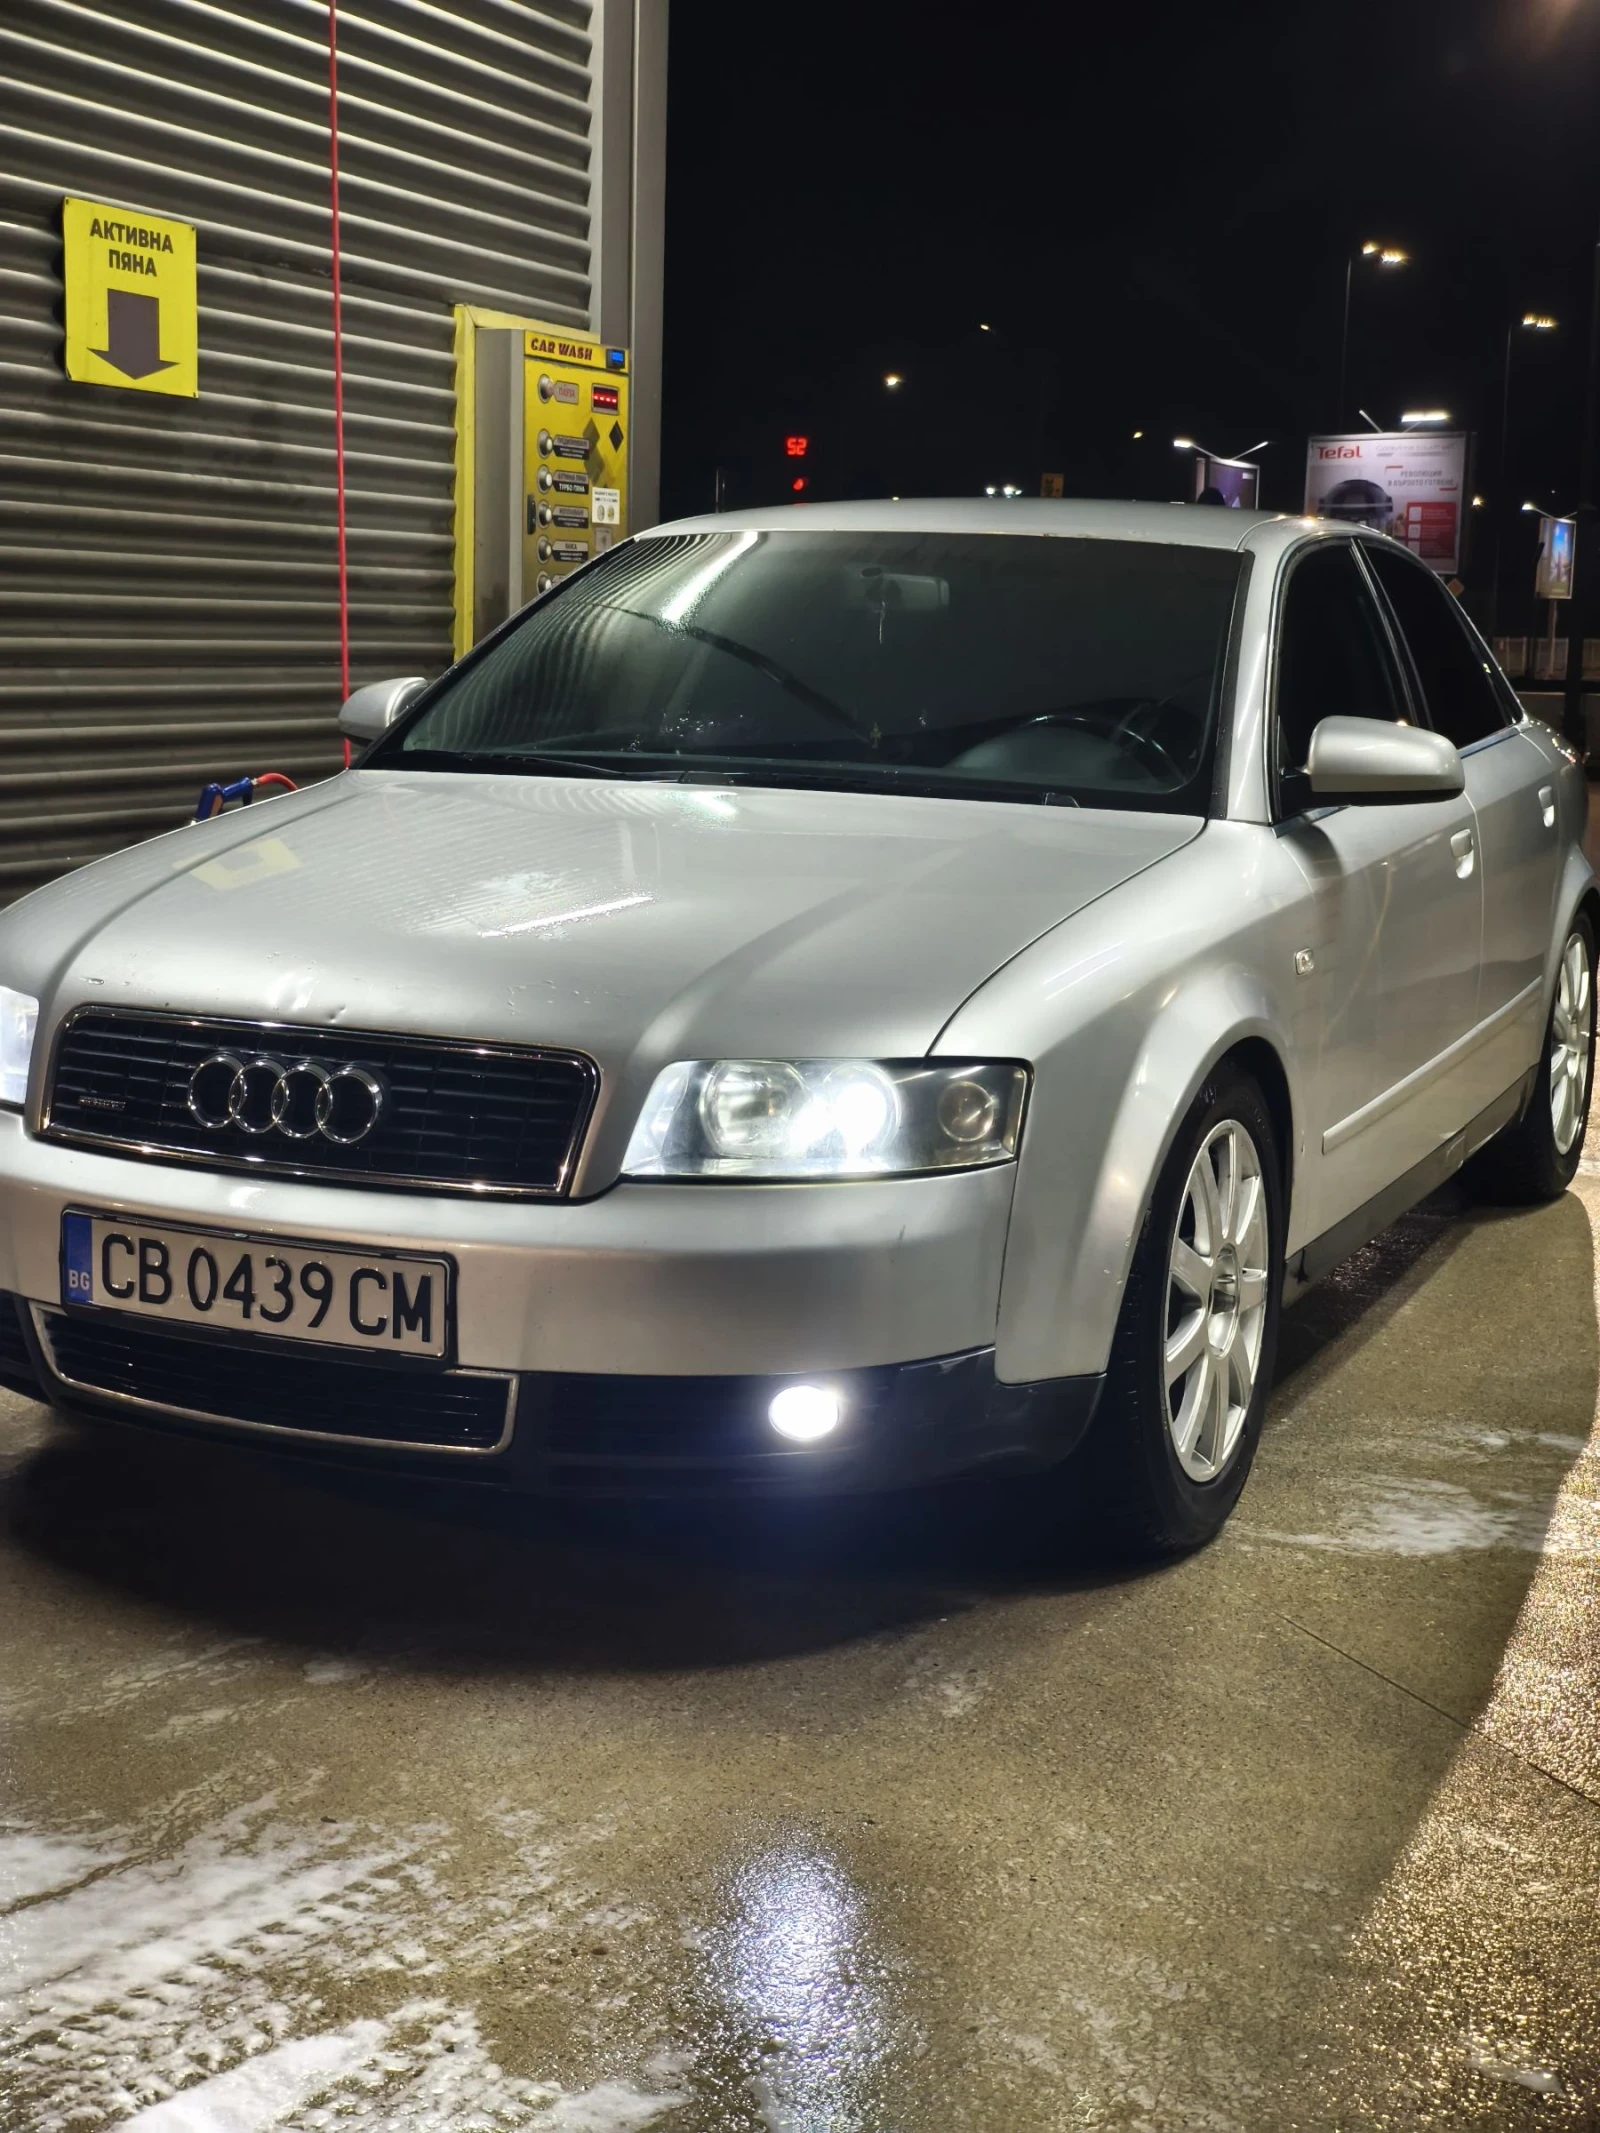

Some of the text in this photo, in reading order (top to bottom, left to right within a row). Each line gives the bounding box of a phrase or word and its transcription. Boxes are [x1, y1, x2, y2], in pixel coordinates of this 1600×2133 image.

[89, 217, 174, 254] АКТИВНА
[108, 248, 158, 277] ПЯНА
[530, 338, 593, 361] CAR WASH
[787, 437, 807, 455] 52
[1316, 445, 1363, 460] Tefal
[69, 1269, 91, 1290] BG
[101, 1232, 432, 1343] CB 0439 CM
